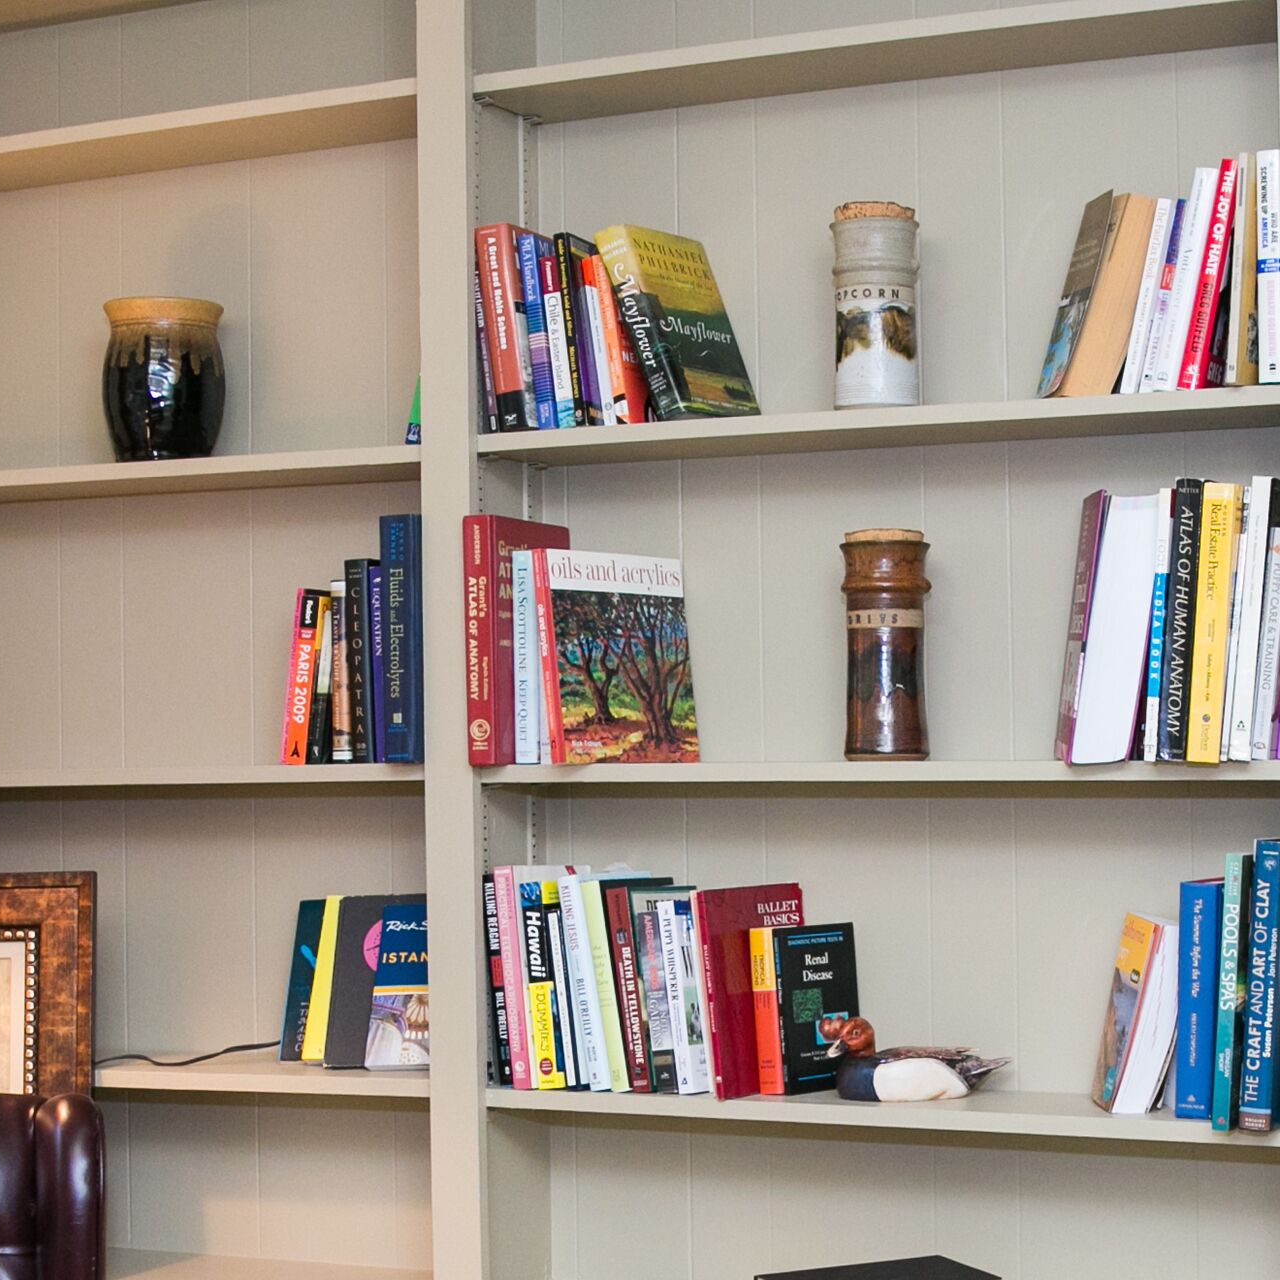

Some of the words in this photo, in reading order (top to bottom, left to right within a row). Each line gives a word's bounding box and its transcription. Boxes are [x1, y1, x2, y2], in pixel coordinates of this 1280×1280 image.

[1221, 168, 1236, 193] THE
[1259, 167, 1267, 203] SCREWING
[1215, 194, 1231, 222] JOY
[1261, 205, 1268, 214] UP
[1211, 222, 1225, 240] OF
[1261, 217, 1269, 248] AMERICA
[488, 245, 499, 269] Great
[520, 239, 532, 260] MLA
[633, 238, 705, 264] NATHANIEL
[1204, 243, 1221, 276] HATE
[491, 271, 501, 287] and
[522, 261, 537, 302] Handbook
[638, 254, 711, 280] PHILBRICK
[493, 289, 504, 314] Noble
[546, 295, 561, 325] Chile
[1198, 282, 1214, 309] GREG
[613, 263, 657, 368] Mayflower
[659, 316, 732, 344] Mayflower
[496, 316, 508, 350] Scheme
[1190, 310, 1209, 353] GUTFELD
[552, 337, 561, 359] Easter
[554, 361, 565, 389] Island
[1211, 503, 1222, 525] Real
[1178, 506, 1196, 554] ATLAS
[1209, 528, 1221, 559] Estate
[517, 568, 527, 593] LISA
[551, 556, 582, 579] oils
[586, 558, 617, 582] and
[621, 561, 681, 591] acrylics
[1176, 558, 1192, 582] OF
[1206, 560, 1219, 600] Practice
[389, 568, 403, 607] Fluids
[468, 576, 477, 616] ATLAS
[478, 576, 487, 617] Grant's
[371, 588, 383, 656] EQUITATION
[1170, 585, 1190, 649] HUMAN
[1267, 595, 1280, 624] CARE
[469, 620, 477, 636] OF
[517, 597, 528, 671] SCOTTOLINE
[1266, 626, 1277, 635] &
[295, 644, 310, 682] PARIS
[350, 587, 364, 734] CLEOPATRA
[386, 624, 404, 698] Electrolytes
[469, 638, 479, 700] ANATOMY
[1261, 636, 1276, 690] TRAINING
[292, 686, 307, 723] 2009
[519, 679, 528, 706] KEEP
[1163, 653, 1185, 736] ANATOMY
[517, 708, 528, 743] QUIET
[484, 882, 496, 914] KILLING
[496, 877, 509, 933] PRACTICAL
[560, 885, 574, 920] KILLING
[757, 900, 798, 914] BALLET
[1193, 899, 1203, 913] The
[1255, 878, 1271, 919] CLAY
[386, 920, 417, 932] Rick
[487, 916, 499, 950] REAGAN
[663, 918, 673, 945] PUPPY
[763, 912, 800, 926] BASICS
[1192, 915, 1202, 943] Summer
[1222, 903, 1238, 957] POOLS
[1254, 921, 1268, 943] OF
[524, 910, 545, 978] Hawaii
[566, 923, 579, 950] JESUS
[642, 914, 656, 960] AMERICAN
[1269, 928, 1279, 961] Peterson
[382, 951, 428, 964] ISTAN
[621, 946, 634, 978] DEATH
[757, 954, 767, 985] TROPICAL
[805, 952, 829, 966] Renal
[1191, 945, 1201, 967] Before
[1223, 960, 1232, 969] &
[1252, 945, 1267, 977] ART
[1268, 963, 1277, 977] Jan
[575, 978, 586, 996] BILL
[626, 980, 636, 991] IN
[666, 949, 678, 1001] WHISPERER
[802, 970, 833, 982] Disease
[1190, 982, 1200, 997] War
[1191, 968, 1200, 980] the
[495, 992, 505, 1007] BILL
[501, 936, 519, 1052] ELECTROCARDIOGRAPHY
[1219, 972, 1235, 1010] SPAS
[1250, 981, 1265, 1015] AND
[534, 992, 551, 1051] DUMMIES
[578, 999, 593, 1037] O'REILLY
[648, 999, 664, 1047] GAIMAN
[1265, 988, 1276, 1028] Peterson
[496, 1009, 508, 1039] O'REILLY
[626, 993, 646, 1064] YELLOWSTONE
[1246, 1018, 1263, 1071] CRAFT
[1263, 1029, 1273, 1057] Susan
[1244, 1075, 1259, 1103] THE
